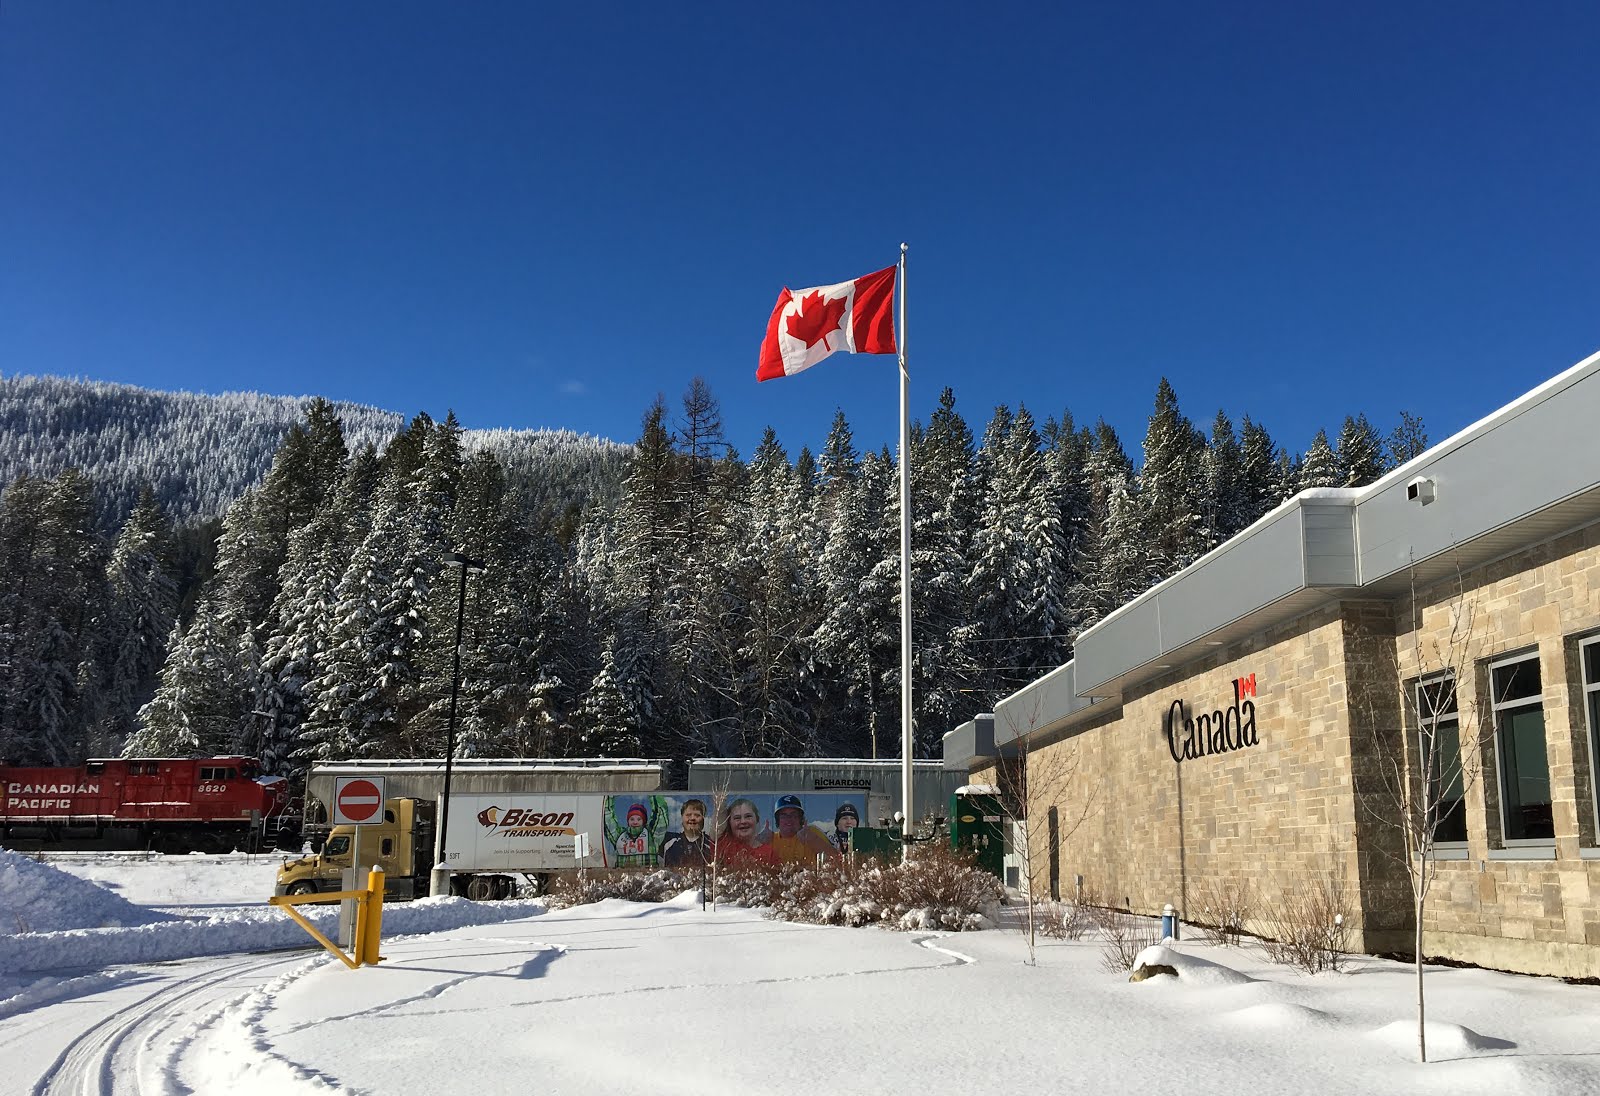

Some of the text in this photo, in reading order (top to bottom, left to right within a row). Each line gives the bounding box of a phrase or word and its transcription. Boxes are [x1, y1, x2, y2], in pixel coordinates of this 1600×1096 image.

[1167, 678, 1260, 763] Canada
[814, 777, 872, 786] RICHARDSON
[8, 782, 99, 794] CANADIAN
[198, 784, 226, 793] 8620
[7, 797, 71, 808] PACIFIC
[499, 809, 574, 827] Bison
[503, 829, 565, 838] TRANSPORT
